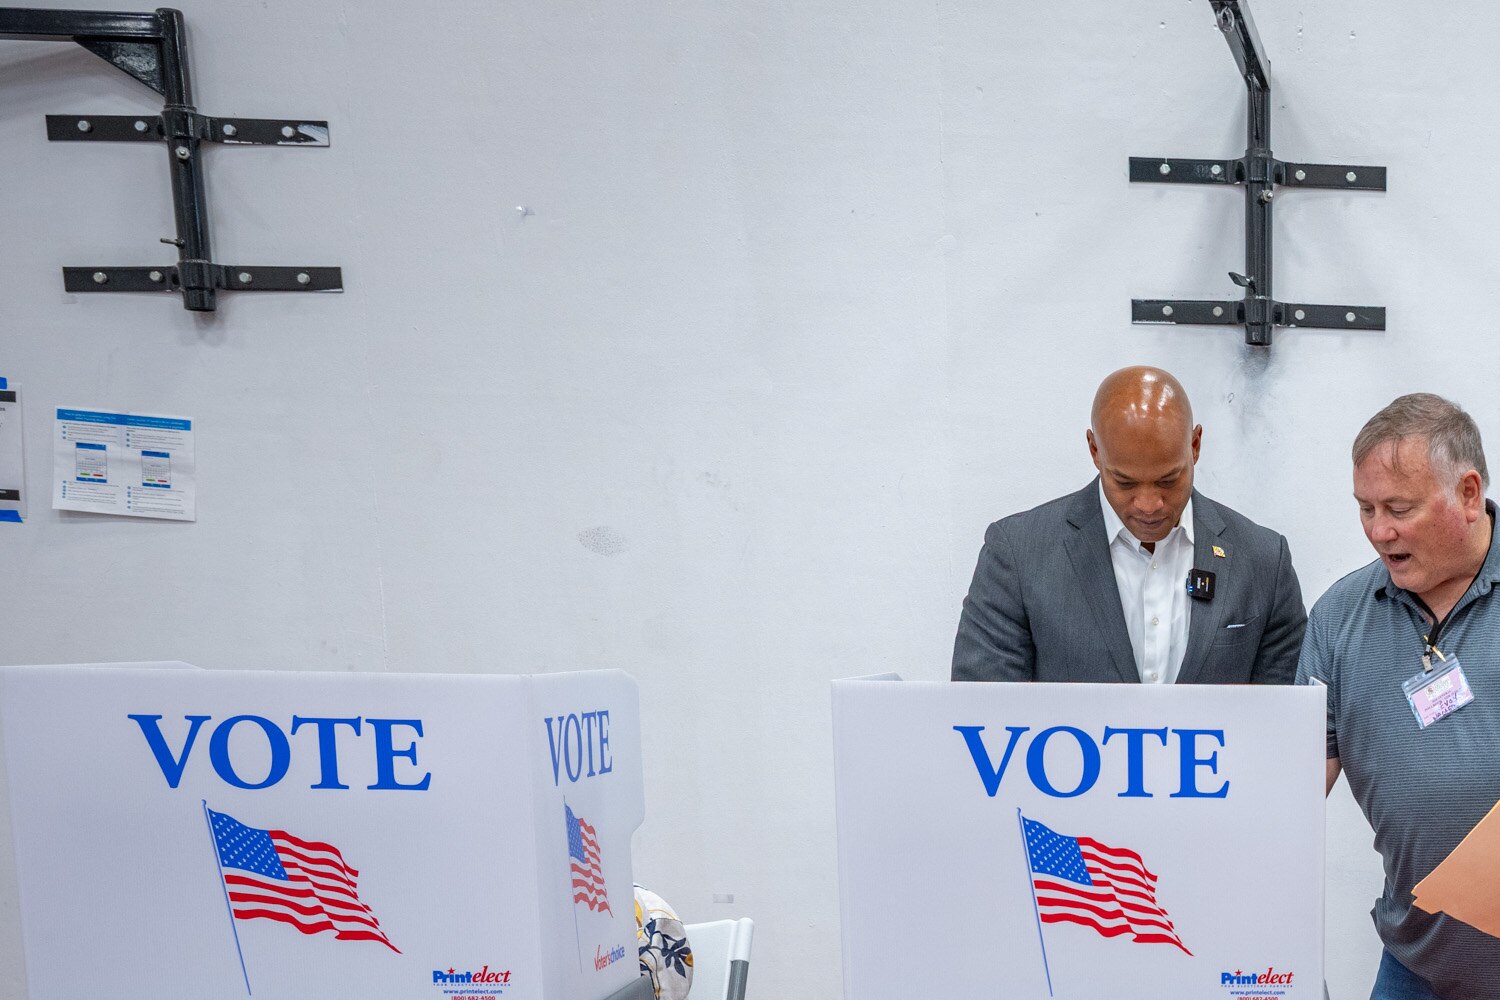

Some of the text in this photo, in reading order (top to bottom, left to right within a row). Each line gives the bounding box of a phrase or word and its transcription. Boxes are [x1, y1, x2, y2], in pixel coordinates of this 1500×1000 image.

[127, 714, 432, 791] VOTE
[544, 709, 613, 787] VOTE
[953, 725, 1230, 799] VOTE
[432, 965, 512, 984] Printelect
[593, 943, 625, 972] Voter's choice
[1221, 966, 1295, 985] Printelect
